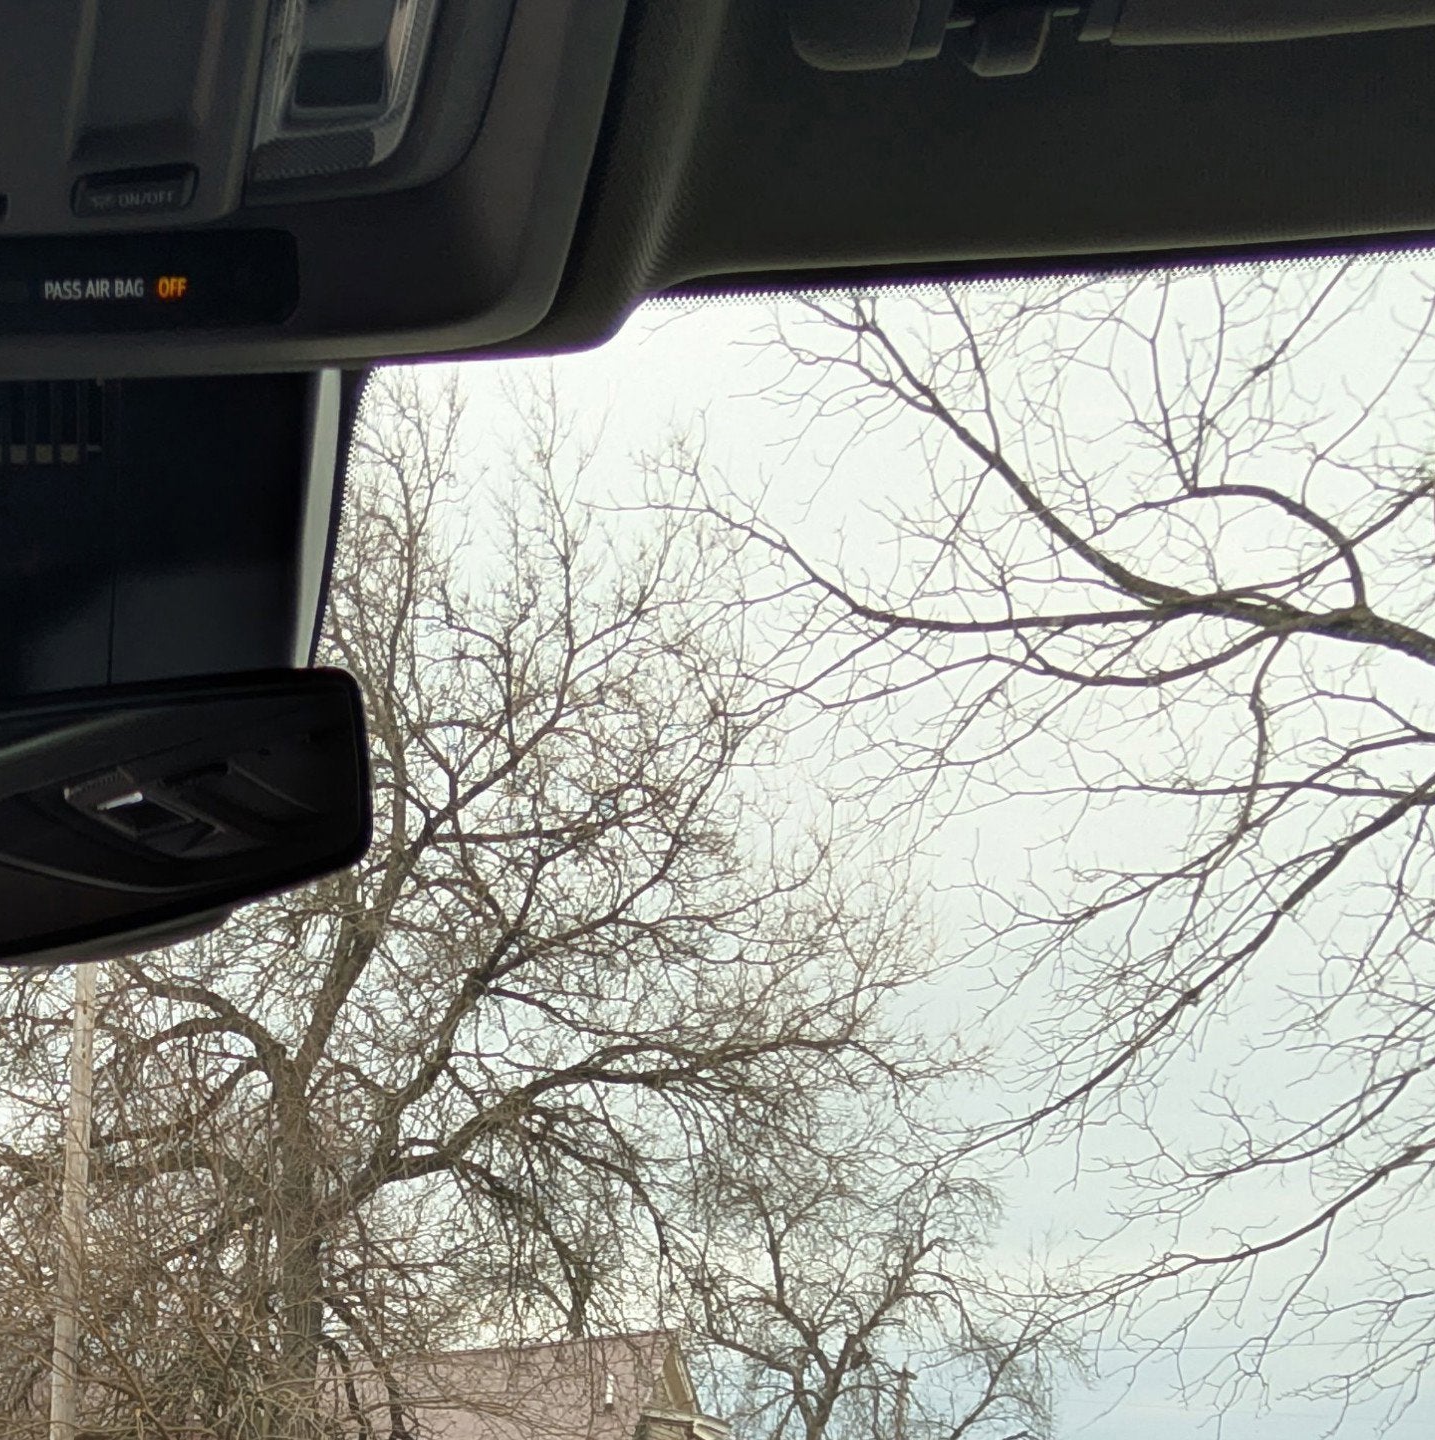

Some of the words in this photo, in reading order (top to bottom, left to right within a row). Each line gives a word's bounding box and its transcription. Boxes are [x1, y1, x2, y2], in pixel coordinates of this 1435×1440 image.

[44, 279, 82, 300] PASS
[85, 278, 110, 299] AIR
[114, 277, 144, 298] BAG
[157, 276, 188, 299] OFF
